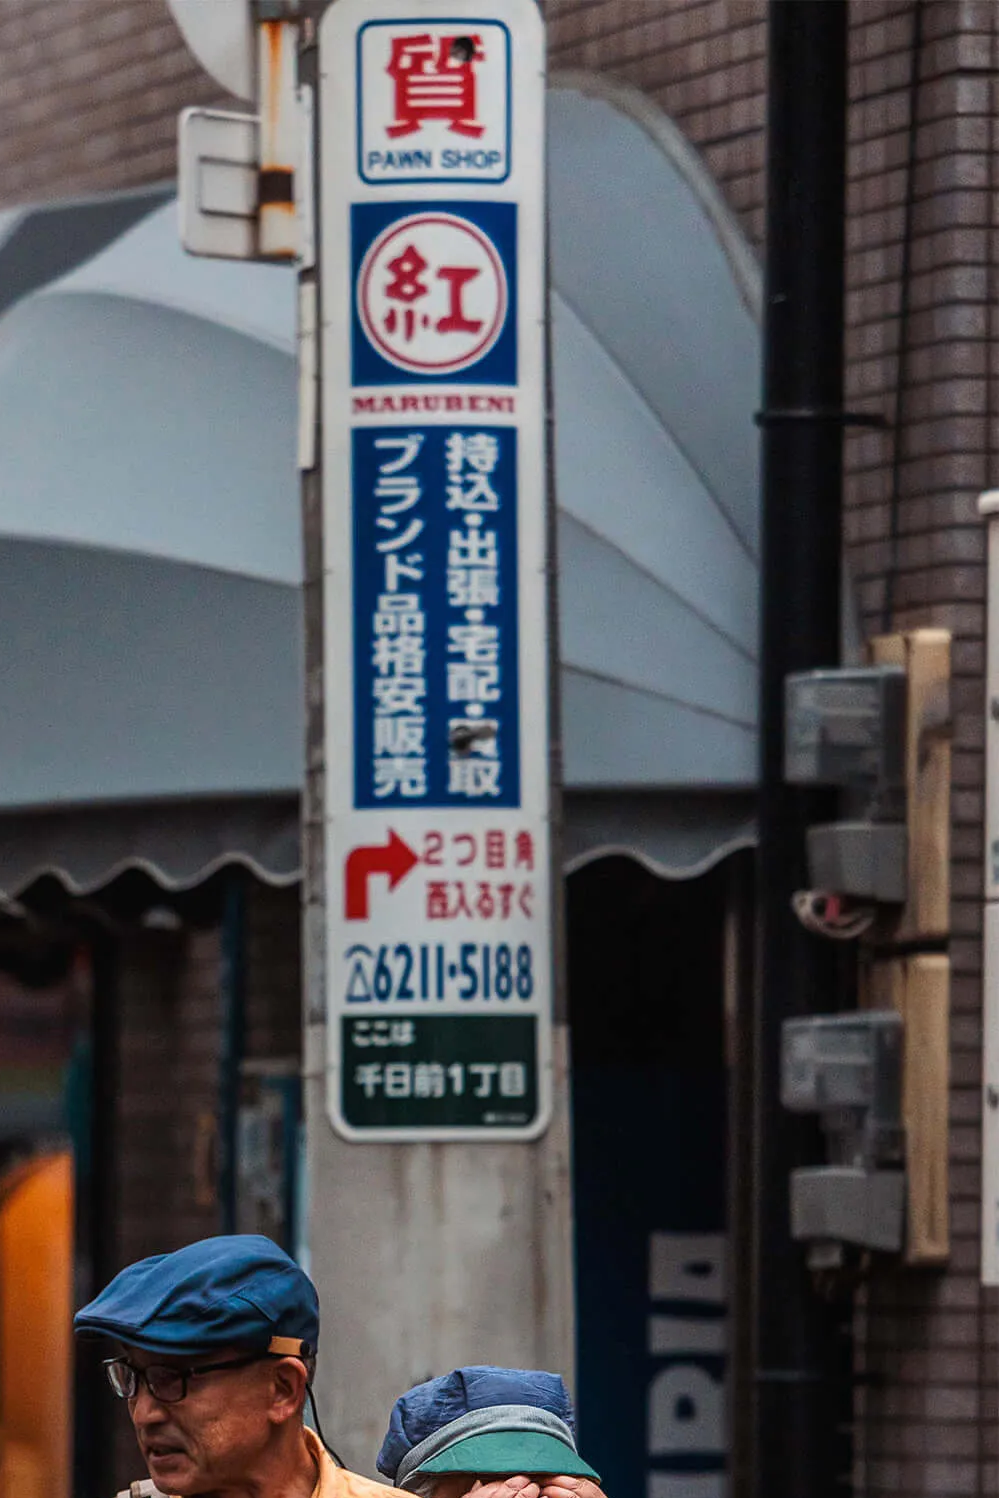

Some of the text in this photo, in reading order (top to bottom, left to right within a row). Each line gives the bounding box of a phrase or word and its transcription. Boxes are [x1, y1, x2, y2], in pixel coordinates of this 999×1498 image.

[384, 33, 486, 139] 質
[368, 150, 501, 170] PAWN SHOP
[384, 244, 485, 343] 紅
[352, 395, 515, 414] MARUBENI
[371, 433, 427, 797] ブランド品格安販売
[352, 1019, 416, 1047] ここは
[354, 1061, 527, 1098] 千日前1丁目
